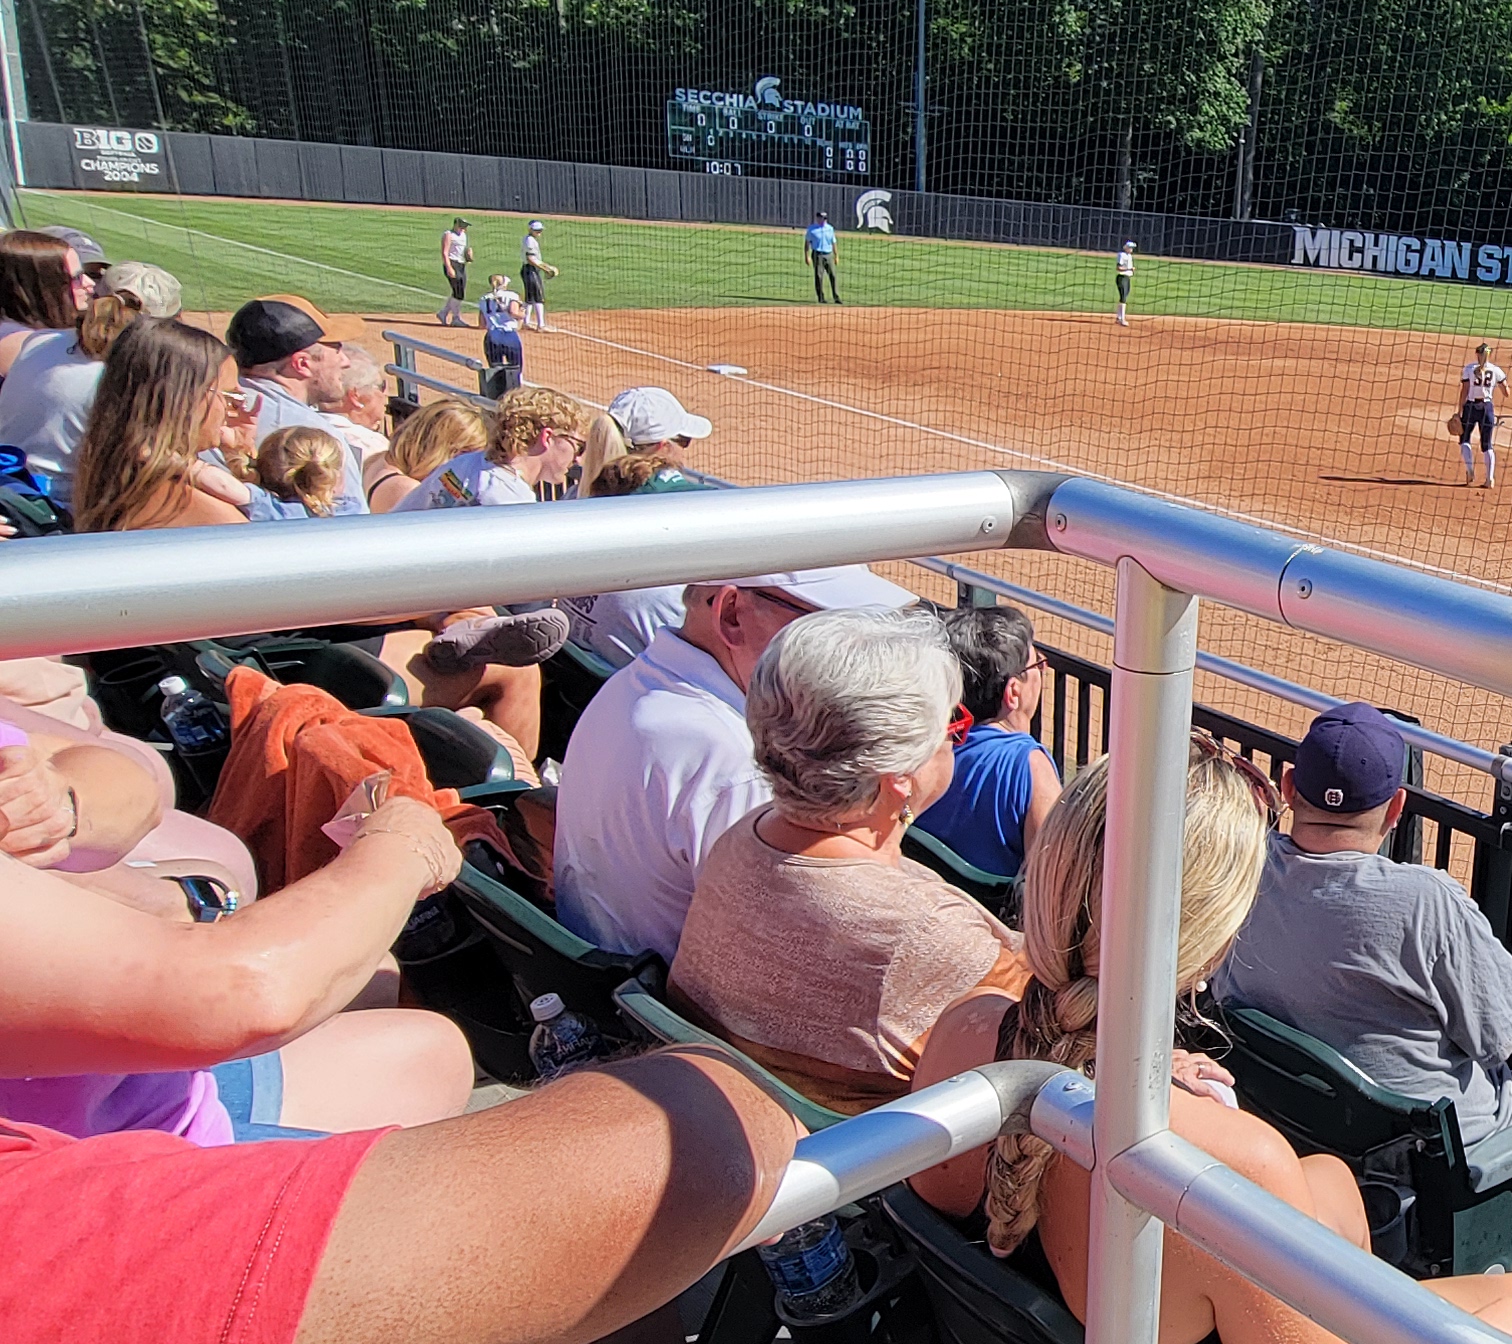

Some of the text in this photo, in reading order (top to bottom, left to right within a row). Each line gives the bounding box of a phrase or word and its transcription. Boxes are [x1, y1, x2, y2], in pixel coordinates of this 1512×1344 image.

[675, 88, 862, 120] SECCHIA STADIUM
[729, 116, 738, 129] 0
[767, 121, 775, 133] 0
[804, 124, 812, 136] 0
[80, 159, 160, 174] CHAMPIONS
[706, 161, 741, 175] 10:07
[103, 170, 139, 182] 2004
[1291, 226, 1473, 279] MICHIGAN
